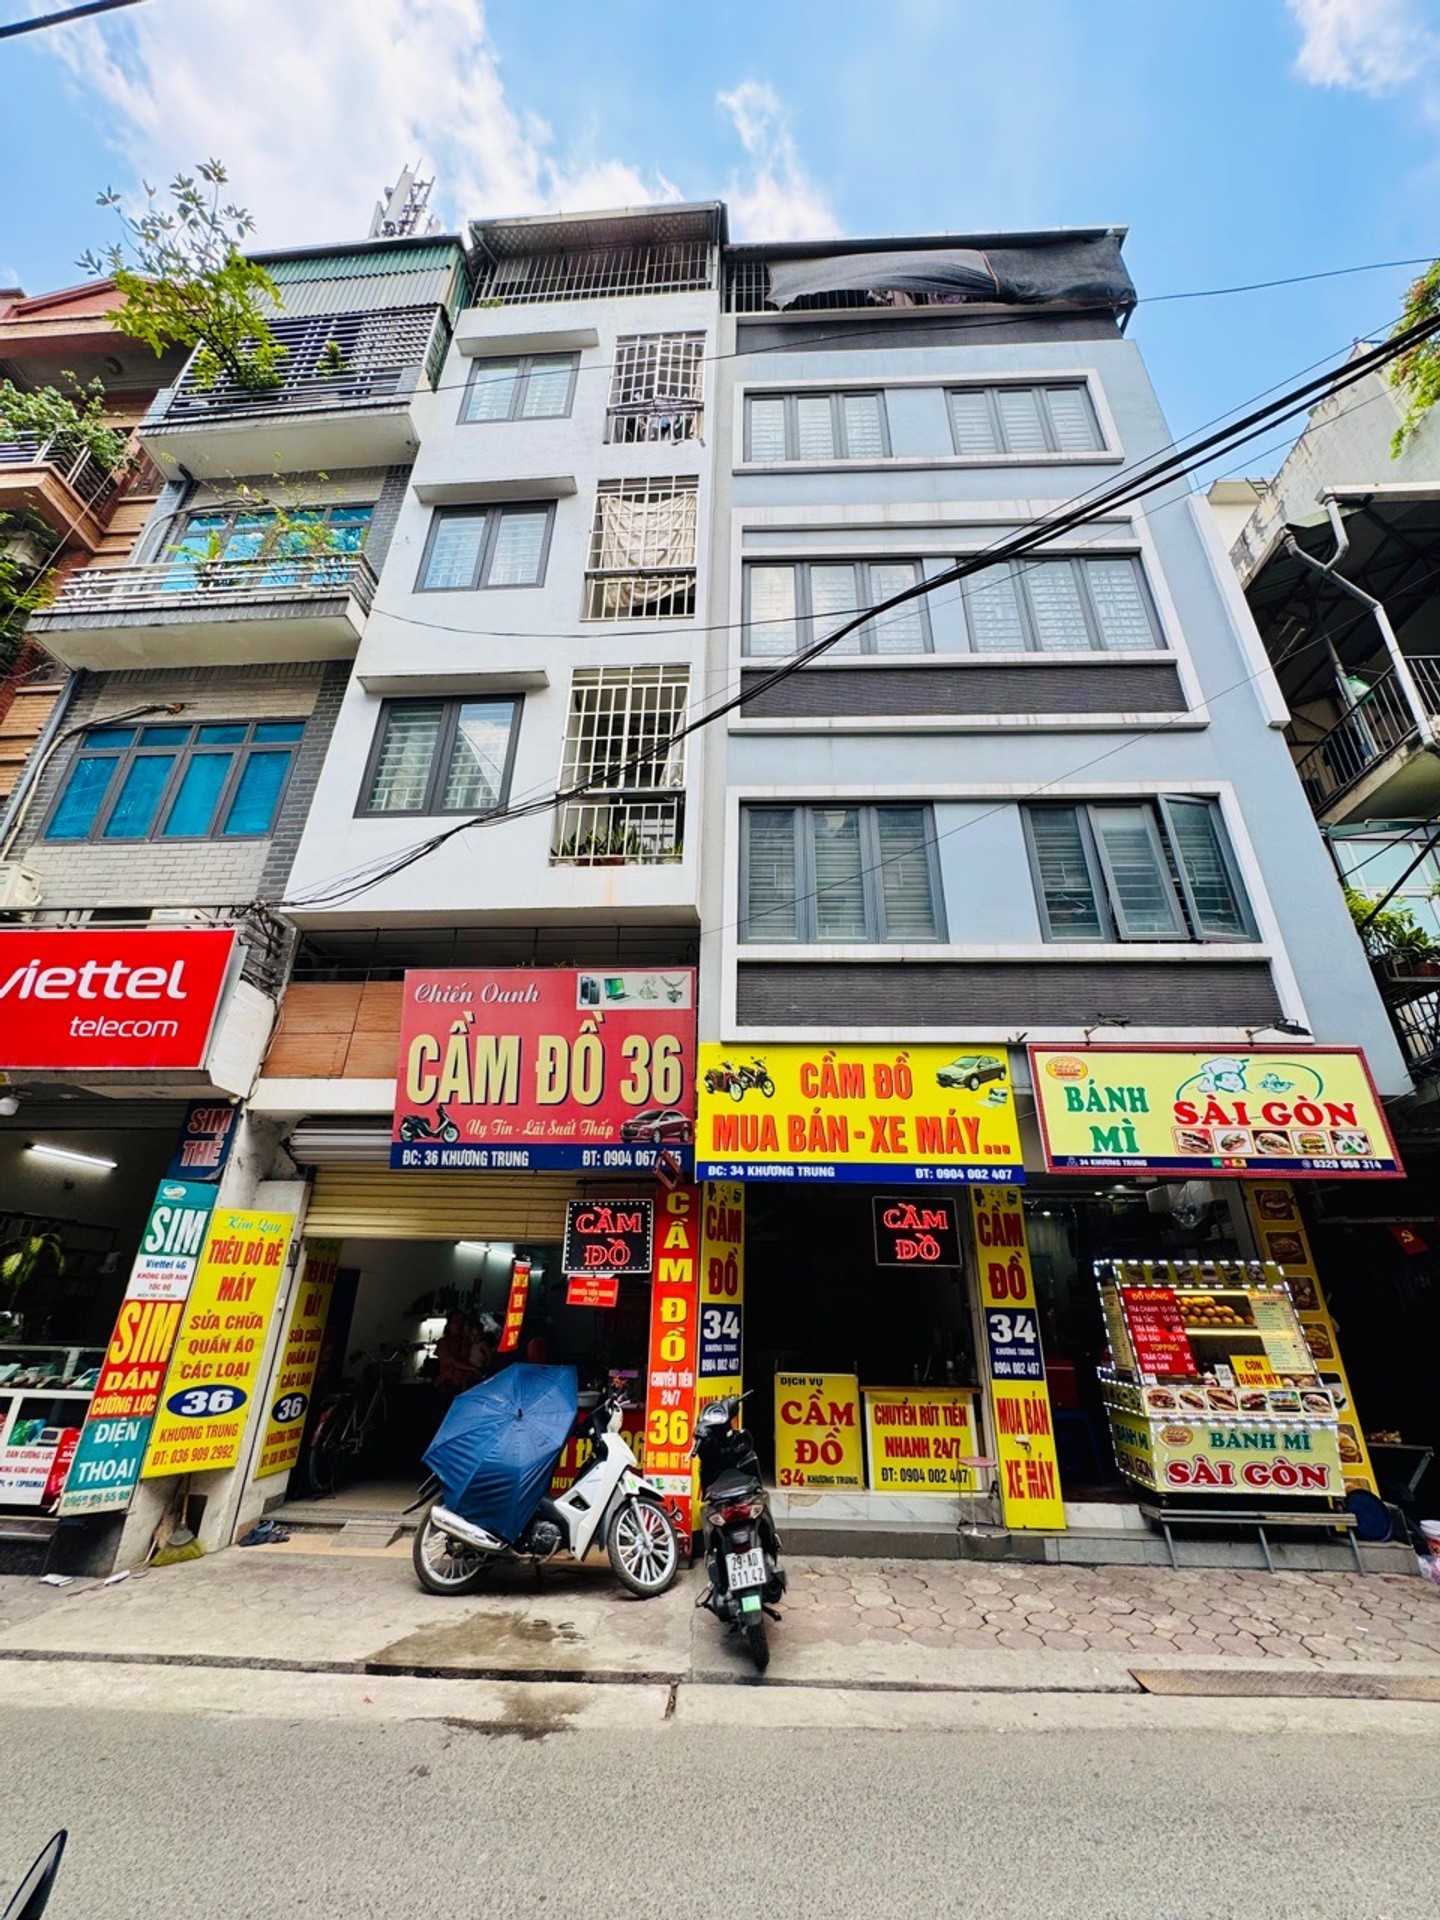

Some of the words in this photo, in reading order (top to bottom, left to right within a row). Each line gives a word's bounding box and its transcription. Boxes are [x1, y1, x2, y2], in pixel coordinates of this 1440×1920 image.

[415, 982, 474, 1003] Chiến
[481, 983, 540, 1003] Oanh
[69, 1016, 178, 1037] telecom
[406, 1011, 522, 1106] CẦM
[535, 1011, 605, 1106] ĐỒ
[620, 1034, 684, 1106] 36
[800, 1050, 866, 1099] CẦM
[872, 1051, 914, 1099] ĐỒ
[1063, 1079, 1149, 1113] BÁNH
[188, 1108, 236, 1133] SIM
[1172, 1094, 1251, 1126] SÀI
[1262, 1095, 1358, 1127] GÒN
[467, 1119, 487, 1138] Uy
[491, 1119, 513, 1136] Tín
[522, 1119, 545, 1136] Lãi
[711, 1114, 779, 1152] MUA
[787, 1107, 849, 1153] BÁN
[869, 1116, 908, 1154] XE
[1089, 1118, 1140, 1153] MÌ
[180, 1133, 224, 1167] THẺ
[402, 1149, 421, 1165] ĐC:
[424, 1150, 439, 1165] 36
[441, 1149, 489, 1166] KHƯƠNG
[491, 1151, 529, 1166] TRUNG
[582, 1150, 600, 1166] ĐT:
[603, 1151, 632, 1166] 0904
[635, 1151, 657, 1166] 067
[708, 1165, 727, 1176] ĐC:
[730, 1165, 744, 1176] 34
[747, 1164, 795, 1177] KHƯƠNG
[797, 1166, 835, 1177] TRUNG
[915, 1168, 934, 1179] ĐT:
[936, 1168, 964, 1179] 0904
[967, 1168, 989, 1179] 002
[991, 1168, 1013, 1180] 407
[1362, 1160, 1382, 1169] 314
[145, 1206, 208, 1254] SIM
[576, 1206, 642, 1233] CẦM
[706, 1199, 741, 1244] CẦM
[883, 1203, 948, 1230] CẦM
[977, 1201, 1024, 1248] CẦM
[207, 1235, 244, 1265] THÊU
[584, 1237, 630, 1266] ĐỒ
[895, 1233, 941, 1260] ĐỒ
[146, 1259, 173, 1268] Viettel
[175, 1261, 187, 1269] 4G
[709, 1249, 739, 1296] ĐỒ
[988, 1251, 1027, 1300] ĐỒ
[216, 1272, 256, 1301] MÁY
[110, 1301, 182, 1364] SIM
[189, 1309, 220, 1330] SỬA
[225, 1311, 264, 1330] CHỮA
[703, 1310, 740, 1339] 34
[990, 1314, 1037, 1343] 34
[233, 1335, 255, 1353] ÁO
[103, 1367, 160, 1391] DÁN
[180, 1360, 213, 1379] CÁC
[215, 1362, 250, 1381] LOẠI
[781, 1377, 806, 1386] DỊCH
[809, 1377, 823, 1386] VỤ
[92, 1392, 133, 1415] CƯỜNG
[132, 1394, 157, 1415] LỰC
[181, 1389, 234, 1414] 36
[278, 1397, 303, 1420] 36
[661, 1390, 681, 1405] 24/7
[781, 1389, 856, 1426] CẦM
[874, 1396, 917, 1426] CHUYỂN
[919, 1401, 939, 1426] RÚT
[942, 1398, 968, 1426] TIỀN
[996, 1398, 1025, 1435] MUA
[1024, 1390, 1050, 1435] BÁN
[94, 1418, 140, 1448] ĐIỆN
[205, 1423, 239, 1439] TRUNG
[648, 1410, 689, 1446] 36
[1209, 1428, 1276, 1450] BÁNH
[1283, 1428, 1312, 1450] MÌ
[151, 1451, 169, 1466] ĐT:
[170, 1449, 190, 1464] 036
[795, 1427, 844, 1466] ĐỒ
[884, 1436, 931, 1458] NHANH
[933, 1437, 961, 1459] 24/7
[78, 1458, 136, 1485] THOẠI
[780, 1468, 805, 1486] 34
[881, 1467, 897, 1481] ĐT:
[900, 1468, 925, 1482] 0904
[928, 1469, 947, 1483] 002
[950, 1469, 968, 1483] 407
[1005, 1460, 1025, 1498] XE
[1025, 1452, 1055, 1500] MÁY
[1167, 1455, 1234, 1485] SÀI
[1244, 1457, 1329, 1488] GÒN
